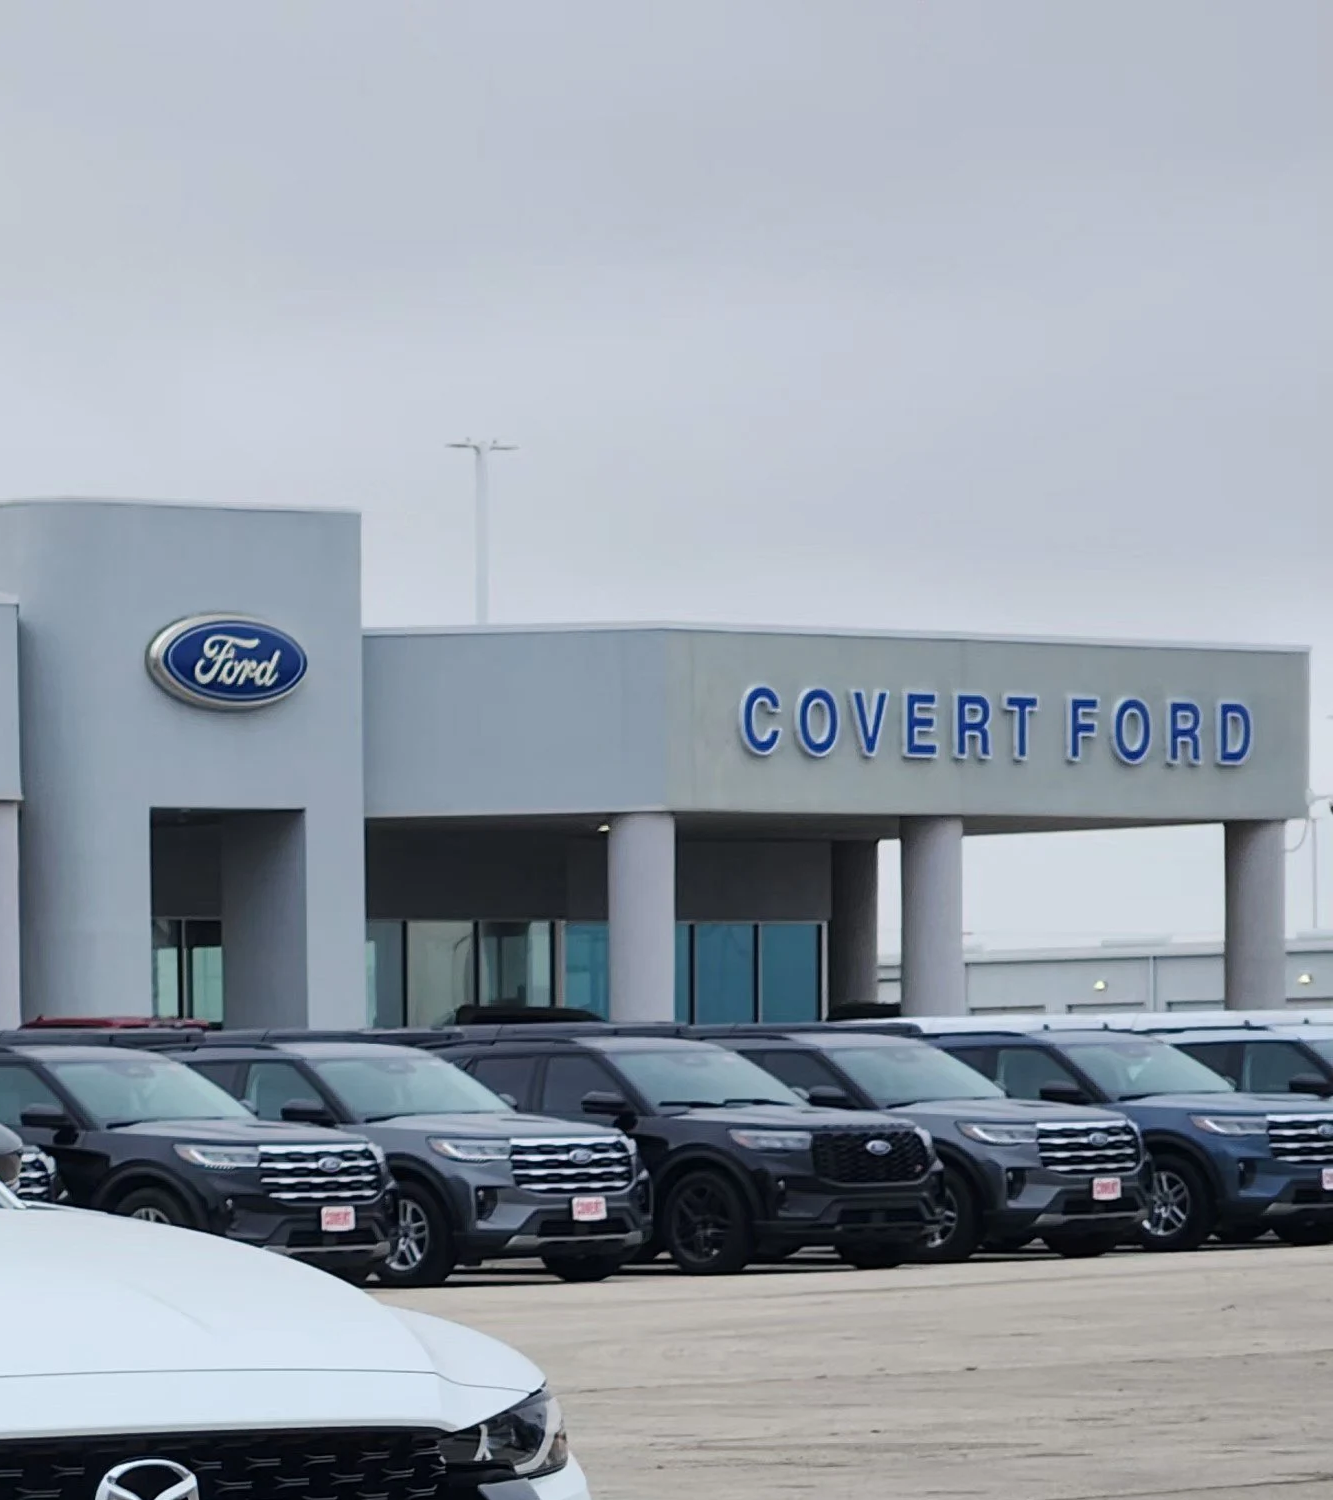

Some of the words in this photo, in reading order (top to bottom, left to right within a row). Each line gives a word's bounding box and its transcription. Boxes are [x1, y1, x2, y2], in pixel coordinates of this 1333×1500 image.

[194, 634, 281, 687] Ford
[741, 684, 1039, 760] COVERT
[1067, 693, 1252, 765] FORD
